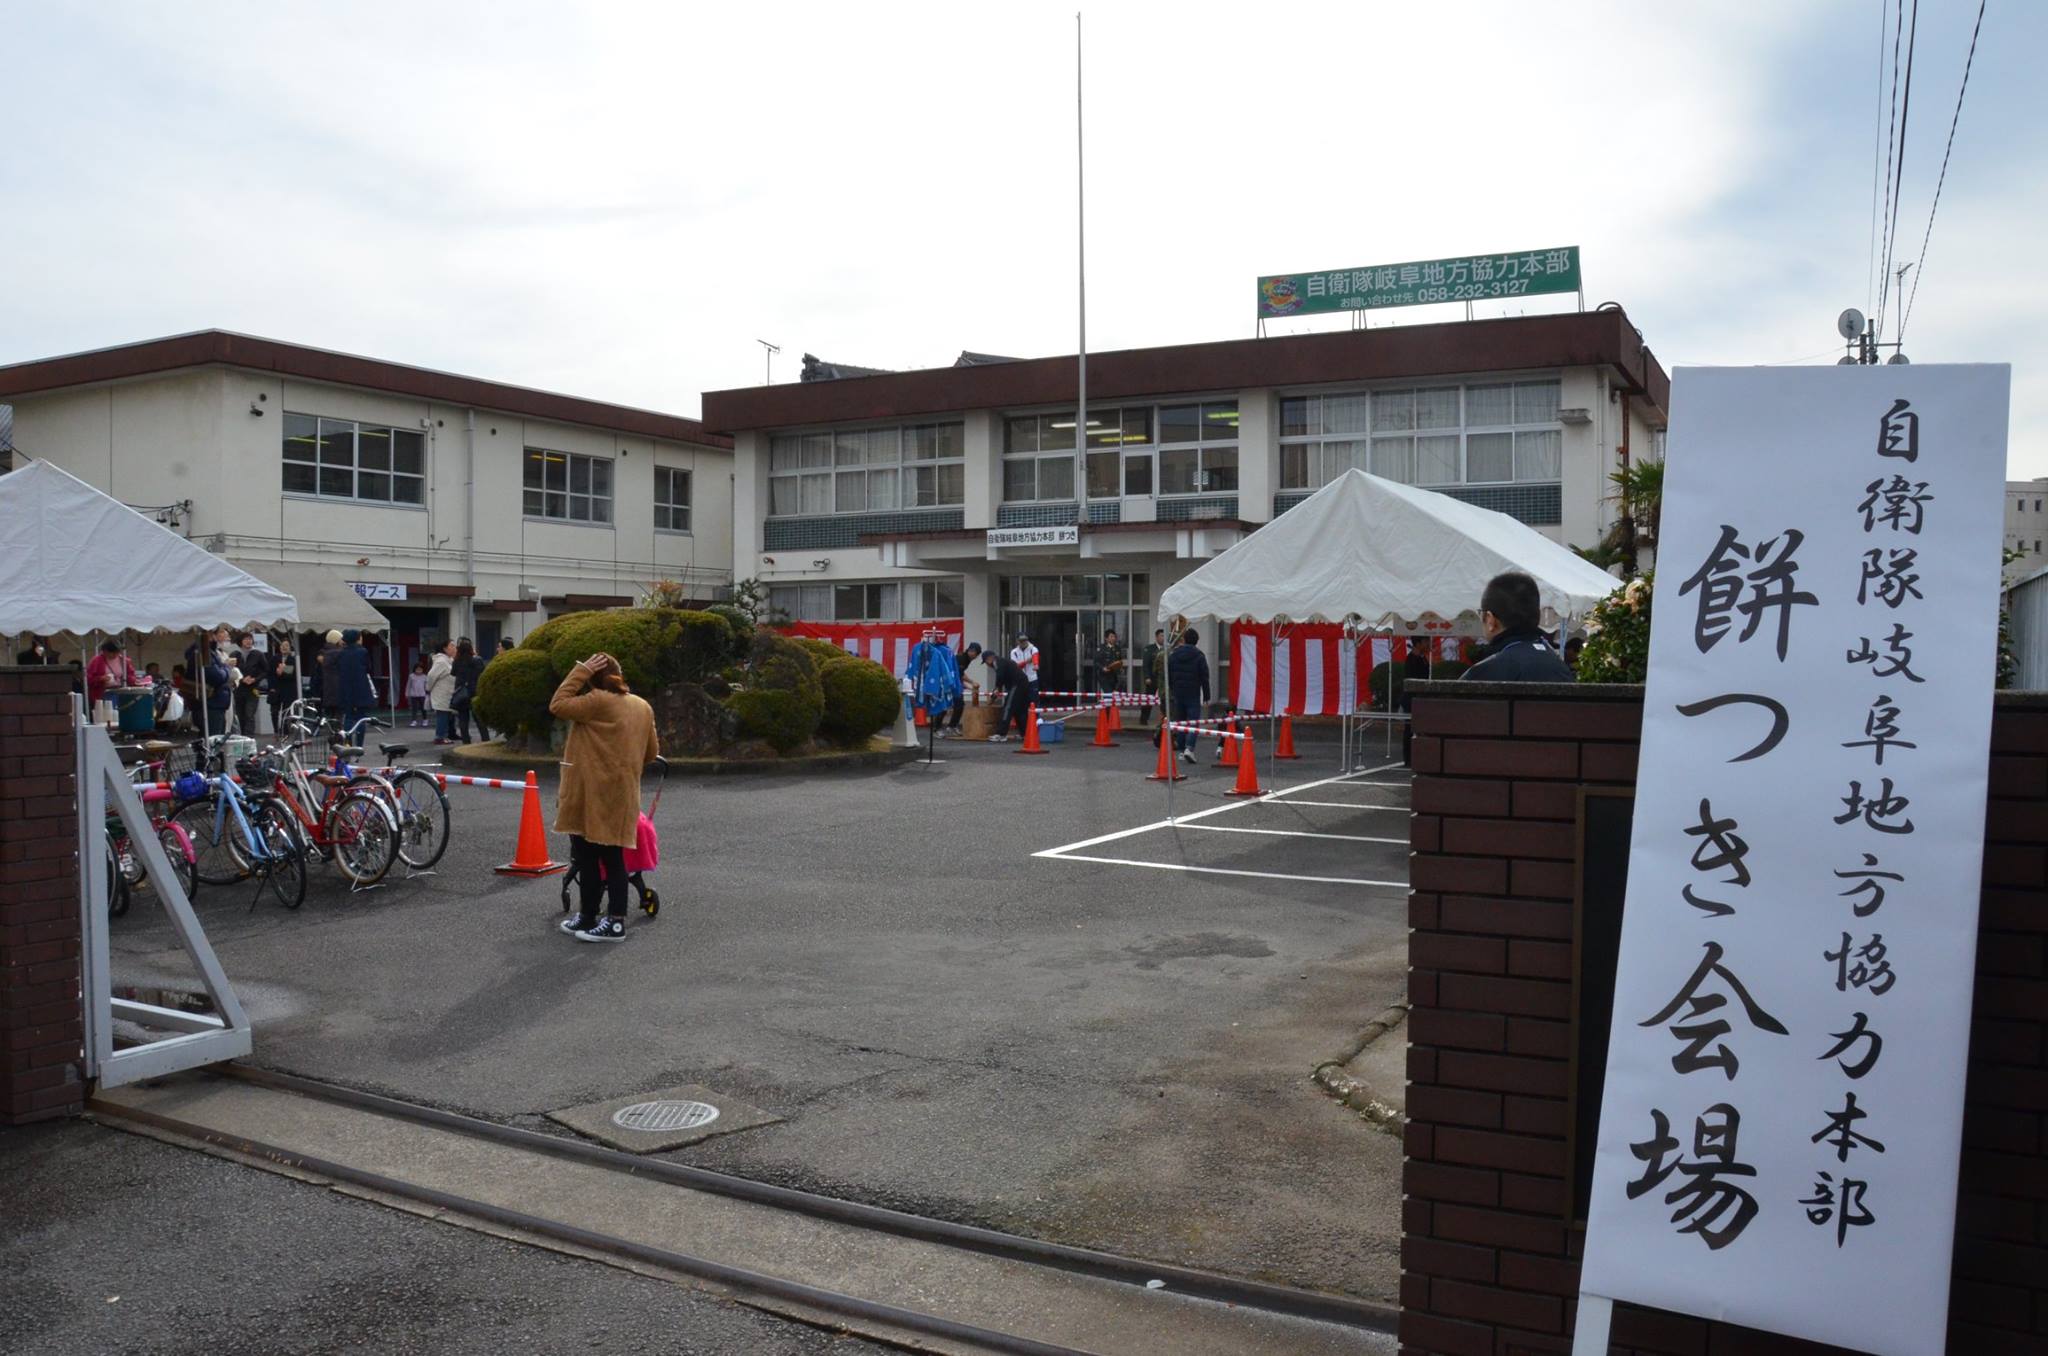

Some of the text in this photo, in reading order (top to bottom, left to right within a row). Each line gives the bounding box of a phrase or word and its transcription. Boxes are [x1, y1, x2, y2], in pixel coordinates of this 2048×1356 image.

[1306, 249, 1570, 297] 自衛隊岐阜地方協力本部
[1340, 279, 1530, 308] お問い合わせ先 058-232-3127
[351, 584, 400, 598] 報ブース
[1798, 398, 1935, 1249] 自衛隊岐阜地方協力本部
[1627, 524, 1820, 1251] 餅つき会場
